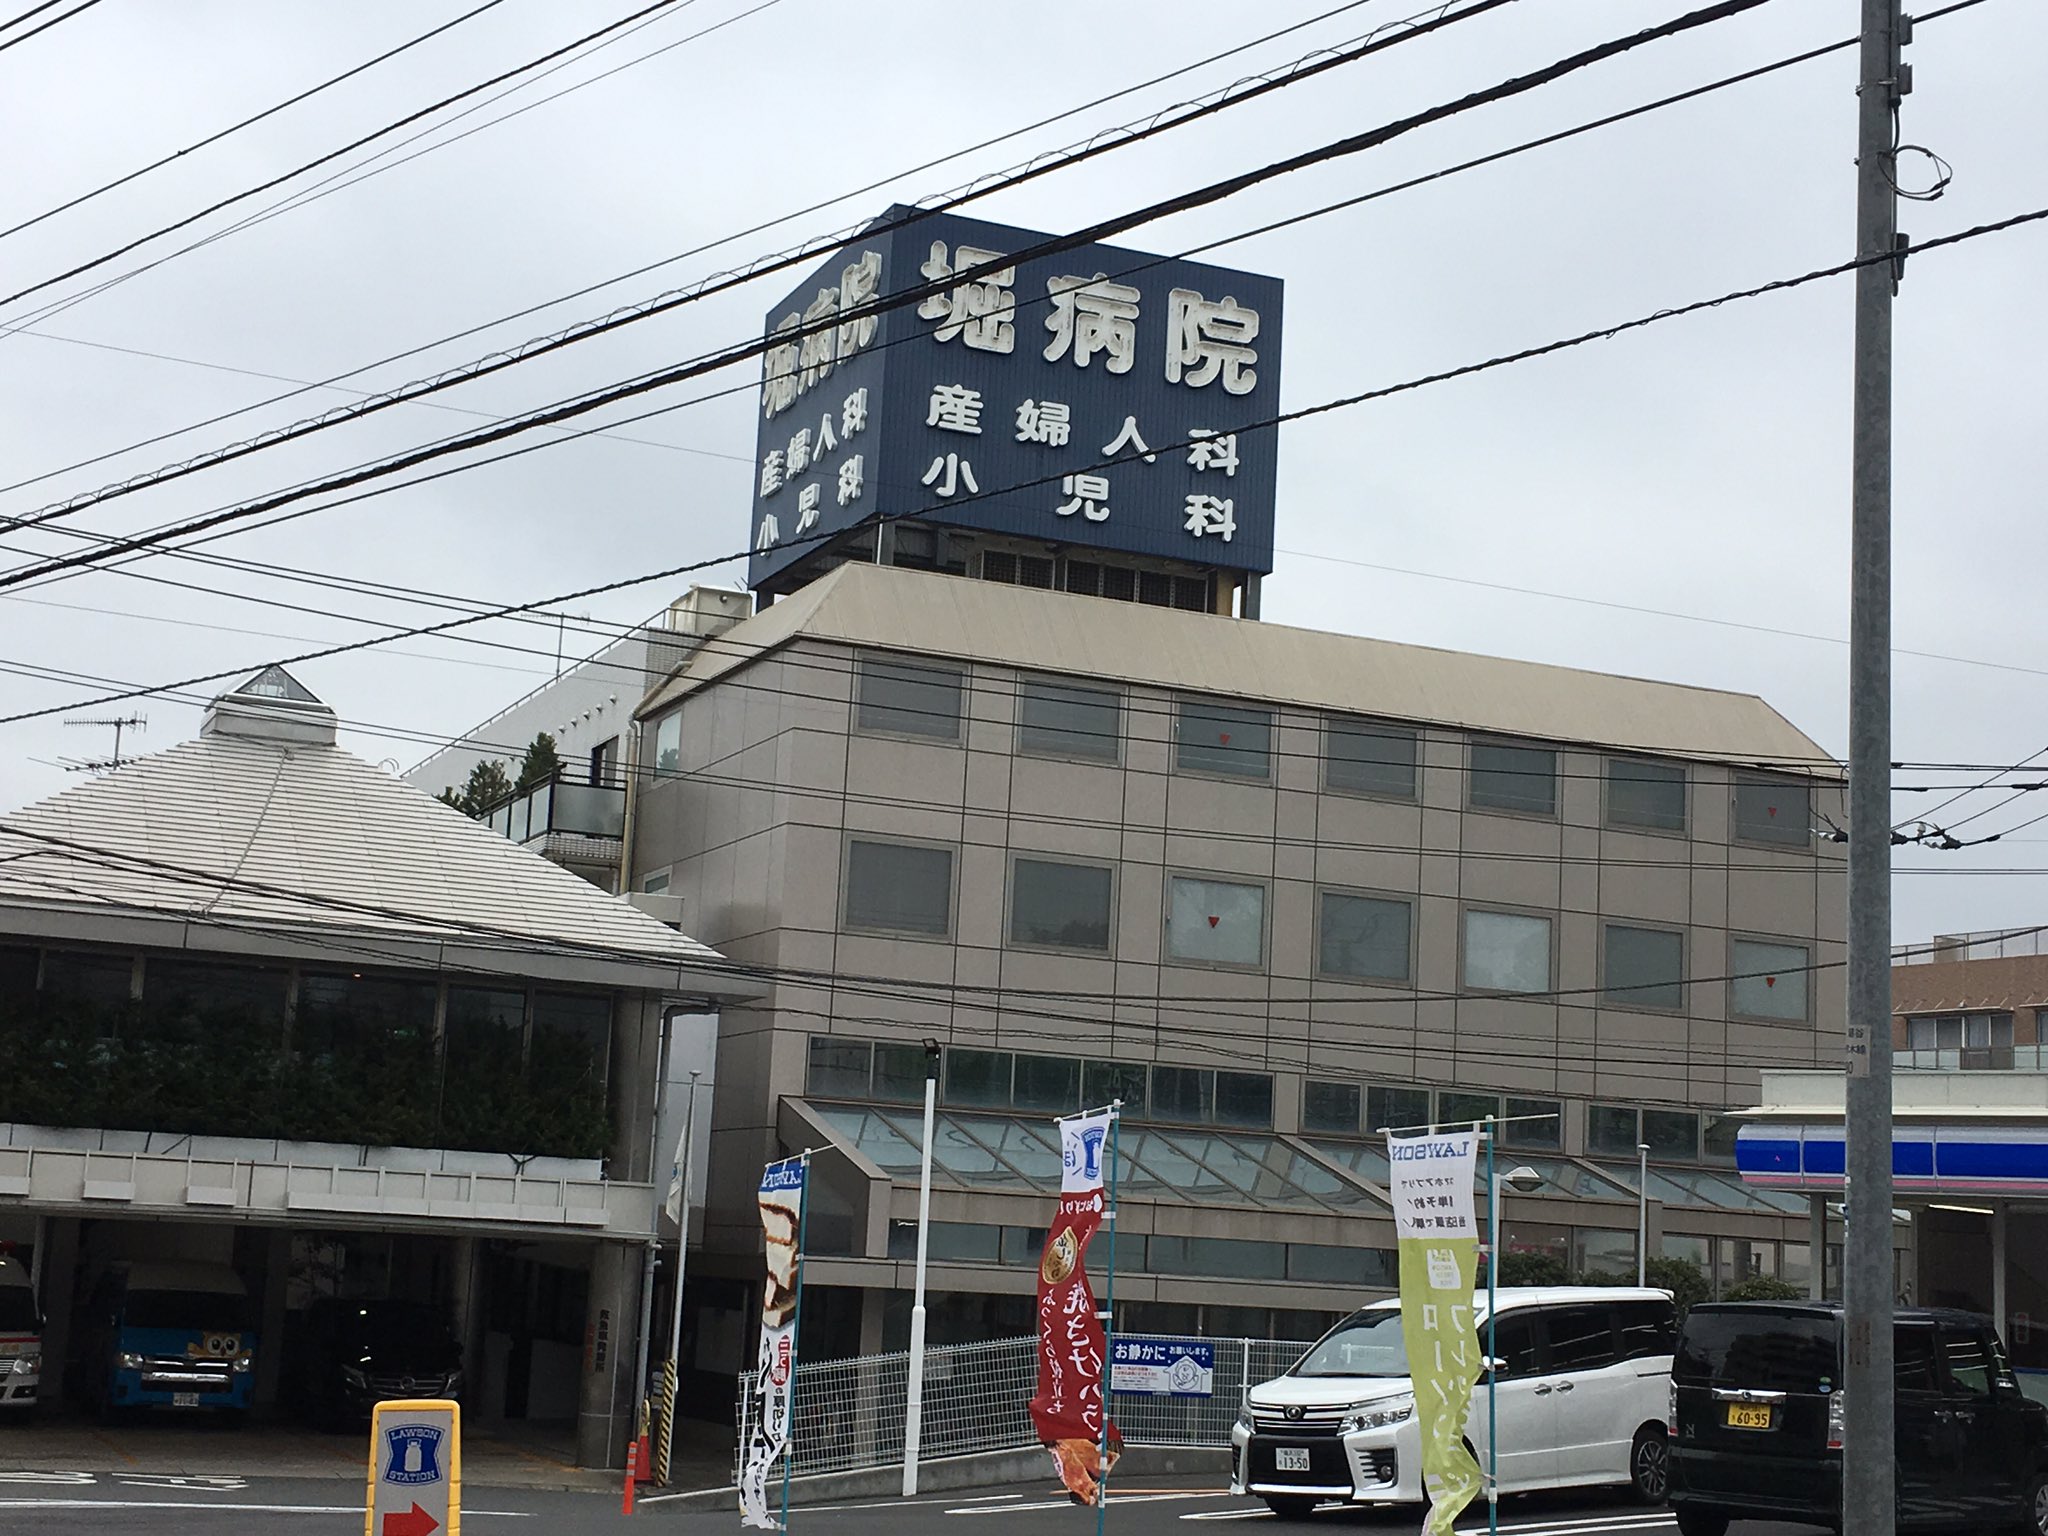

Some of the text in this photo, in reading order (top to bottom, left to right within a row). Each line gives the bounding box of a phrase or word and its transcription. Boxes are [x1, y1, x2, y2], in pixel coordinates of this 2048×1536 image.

[762, 250, 882, 420] 堀病院
[917, 239, 1260, 396] 堀病院
[760, 387, 868, 498] 産婦人科
[926, 384, 1241, 477] 産婦人科
[756, 454, 864, 557] 小児科
[921, 452, 1237, 542] 小児科
[1114, 1343, 1167, 1361] お静かに
[390, 1428, 440, 1441] LAWSON
[1284, 1457, 1308, 1470] 13-50
[1737, 1411, 1768, 1426] 60-95
[388, 1469, 436, 1482] STATION
